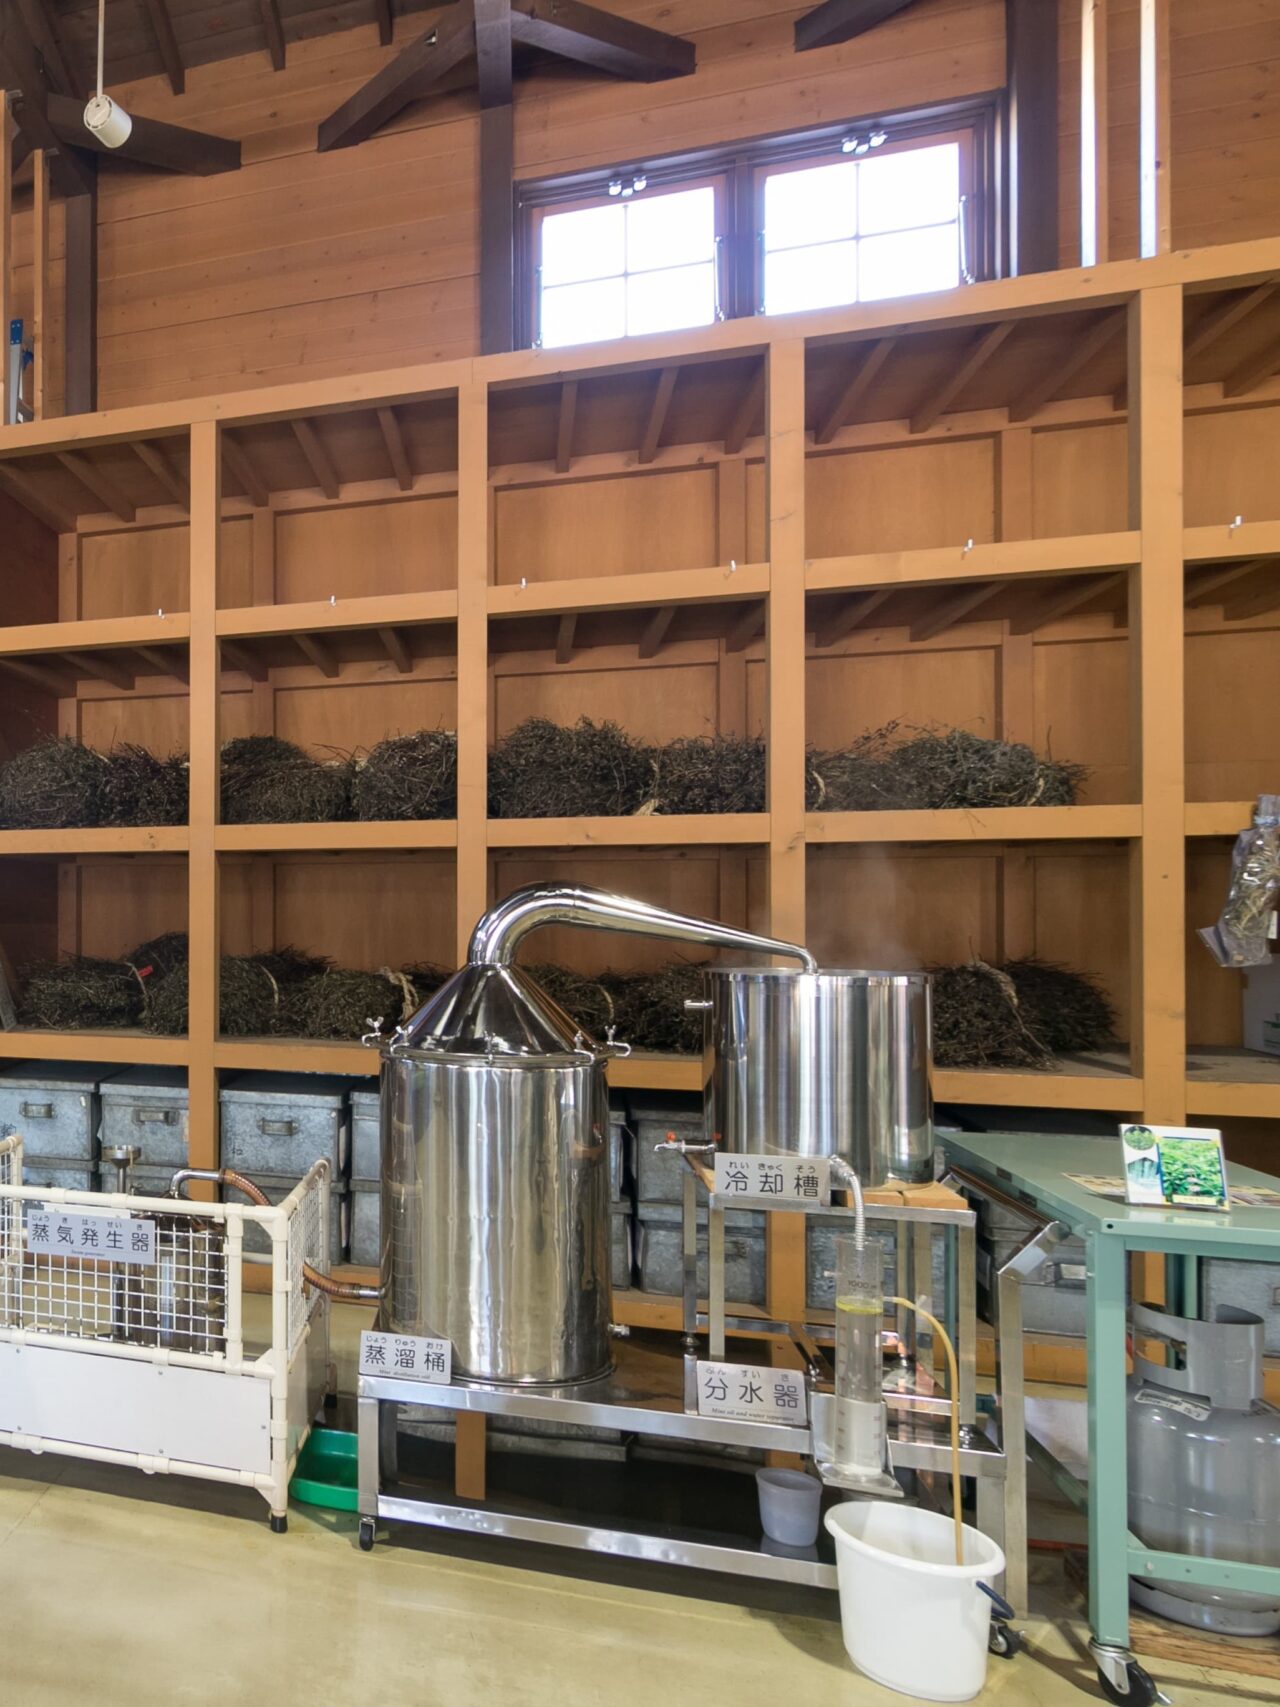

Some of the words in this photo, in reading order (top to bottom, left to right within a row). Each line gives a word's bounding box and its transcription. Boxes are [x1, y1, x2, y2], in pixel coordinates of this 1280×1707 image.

[729, 1161, 749, 1170] れい
[795, 1164, 816, 1174] そう
[724, 1170, 819, 1198] 冷却槽
[31, 1214, 50, 1222] じょう
[31, 1222, 150, 1253] 蒸気発生器
[366, 1335, 387, 1344] じょう
[395, 1338, 416, 1347] りゅう
[426, 1342, 443, 1351] おけ
[365, 1345, 445, 1373] 蒸溜桶
[741, 1369, 761, 1379] すい
[704, 1377, 799, 1409] 分水器
